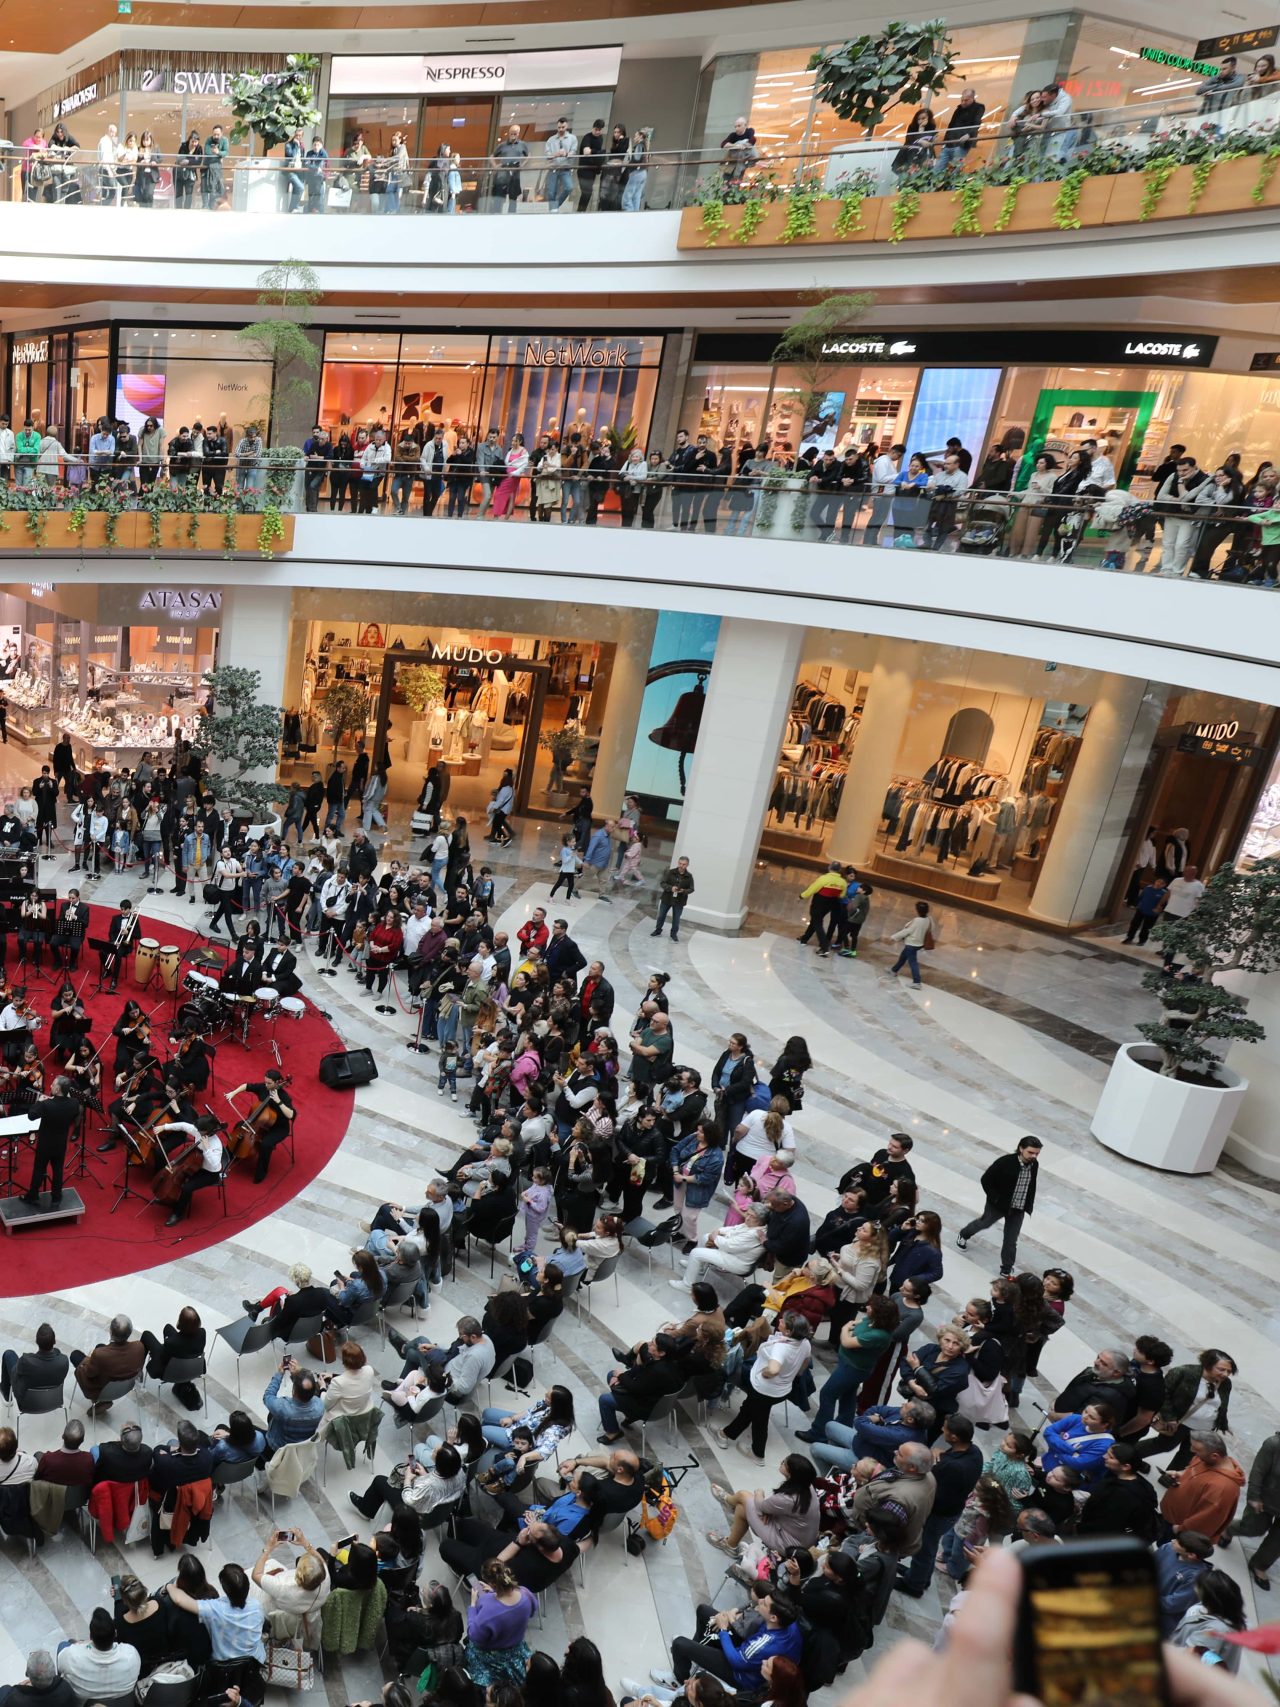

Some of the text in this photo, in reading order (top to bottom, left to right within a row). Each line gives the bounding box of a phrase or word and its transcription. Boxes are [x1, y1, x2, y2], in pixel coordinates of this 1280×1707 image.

[424, 66, 505, 82] NESPRESSO
[61, 83, 98, 115] SWAROVSKI
[524, 342, 629, 366] NetWork
[822, 342, 886, 354] LACOSTE
[1125, 342, 1182, 356] LACOSTE
[217, 383, 249, 391] NetWork
[141, 592, 222, 609] ATASA
[171, 610, 200, 618] 1937
[432, 643, 503, 665] MUDO
[1196, 721, 1239, 740] MUDO
